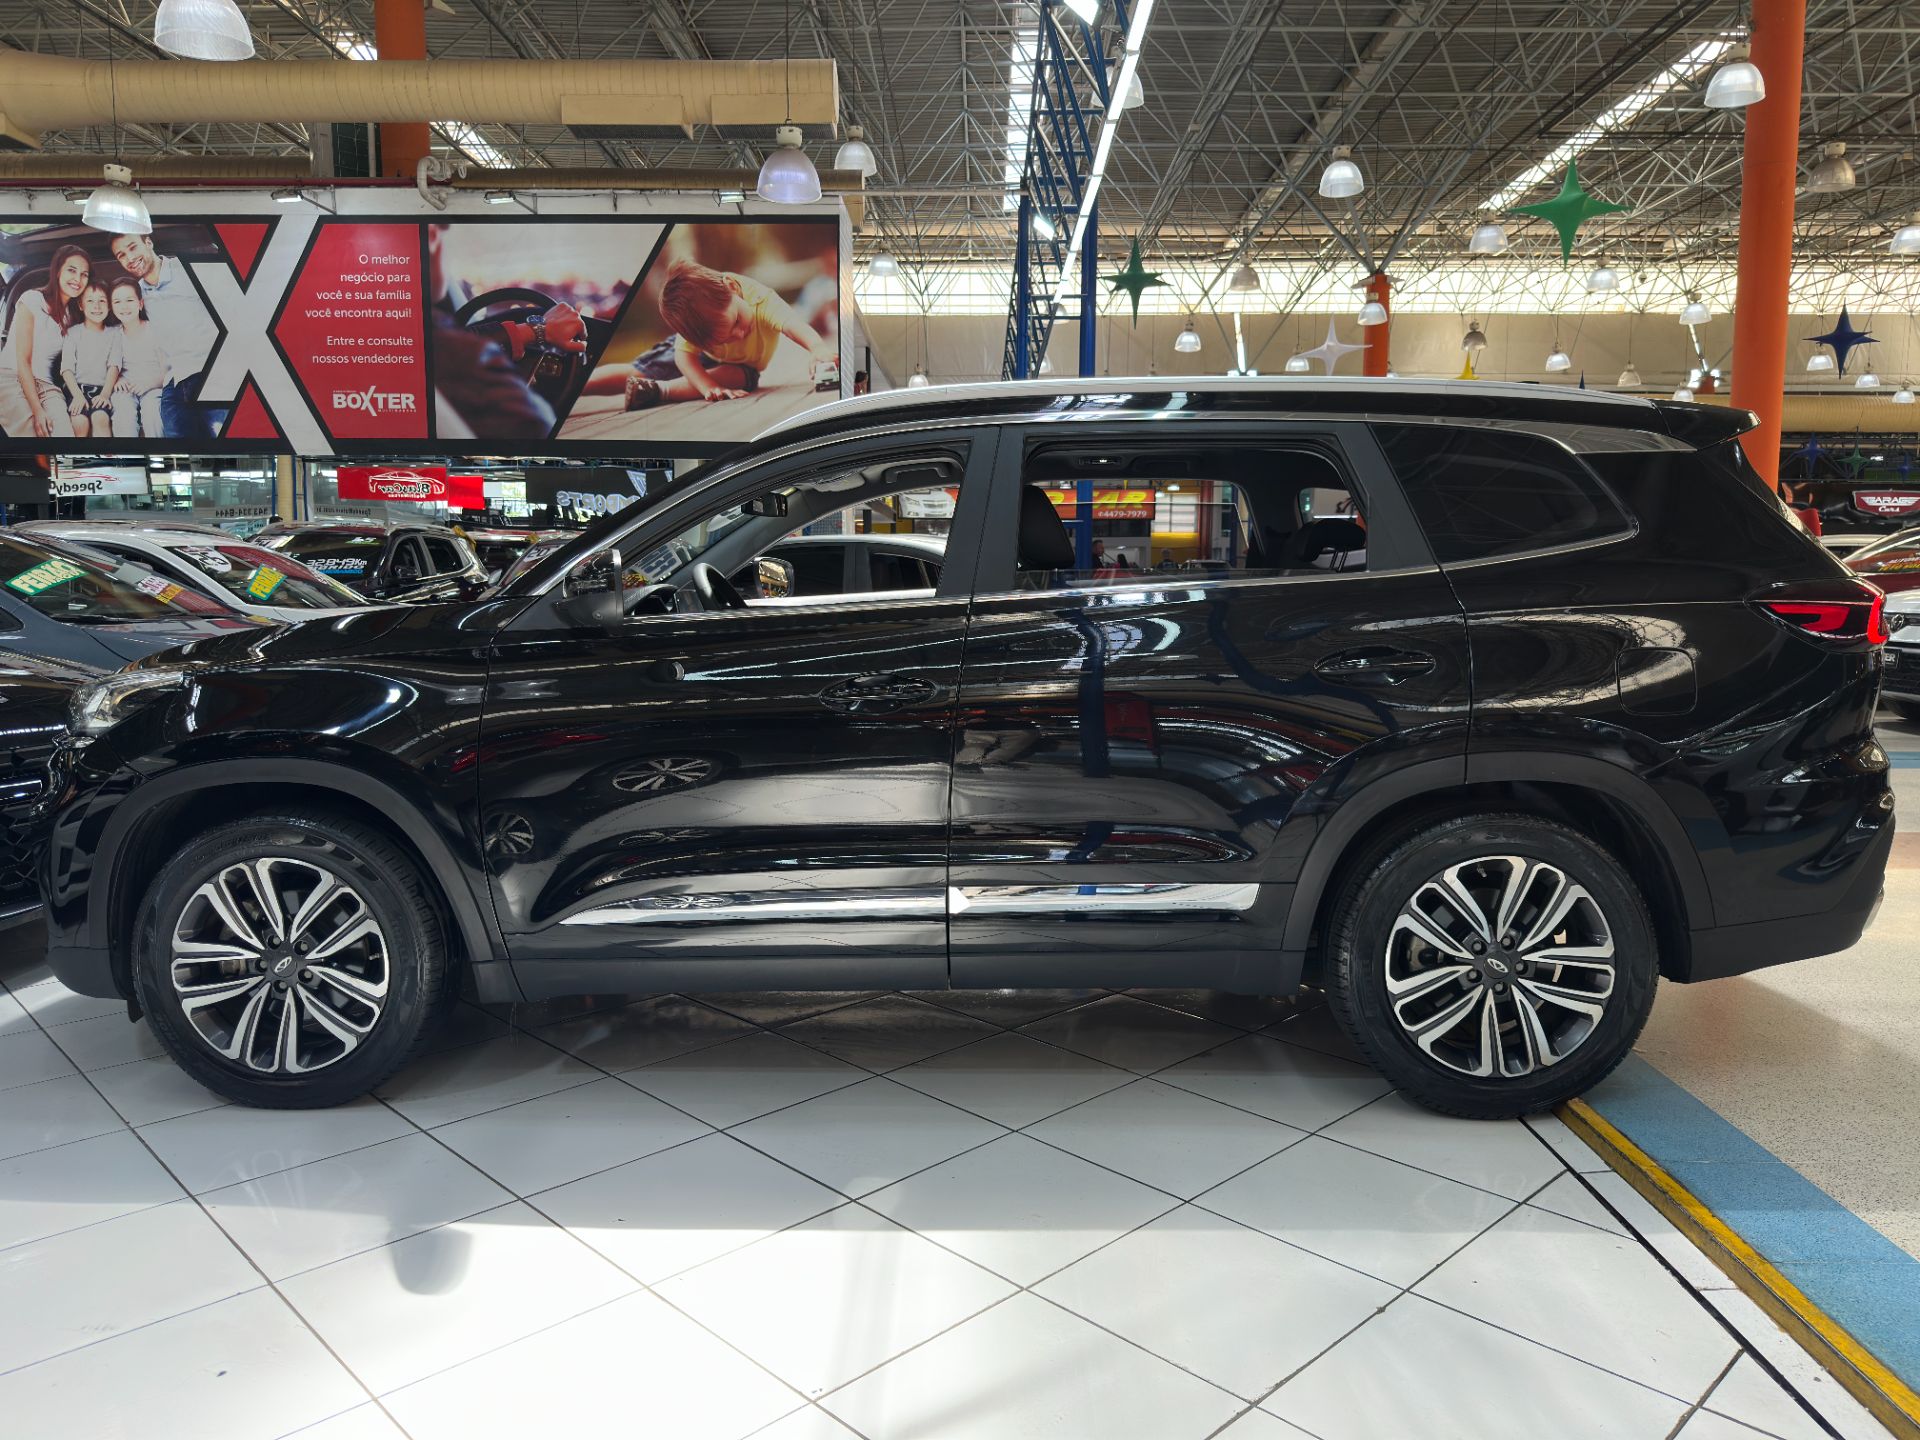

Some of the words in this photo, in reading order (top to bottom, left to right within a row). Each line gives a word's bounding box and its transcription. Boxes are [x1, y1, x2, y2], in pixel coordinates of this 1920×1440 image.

[359, 254, 368, 265] O
[371, 254, 410, 265] melhor
[340, 272, 385, 284] negócio
[387, 274, 411, 284] para
[316, 290, 342, 300] você
[345, 292, 352, 300] e
[354, 292, 373, 300] sua
[376, 290, 411, 300] família
[305, 308, 331, 318] você
[334, 309, 383, 318] encontra
[385, 308, 412, 320] aqui!
[326, 335, 355, 346] Entre
[358, 338, 364, 346] e
[367, 335, 413, 346] consulte
[312, 355, 349, 364] nossos
[352, 354, 414, 364] vendedores
[332, 385, 416, 416] BOXTER
[1094, 491, 1147, 509] AR
